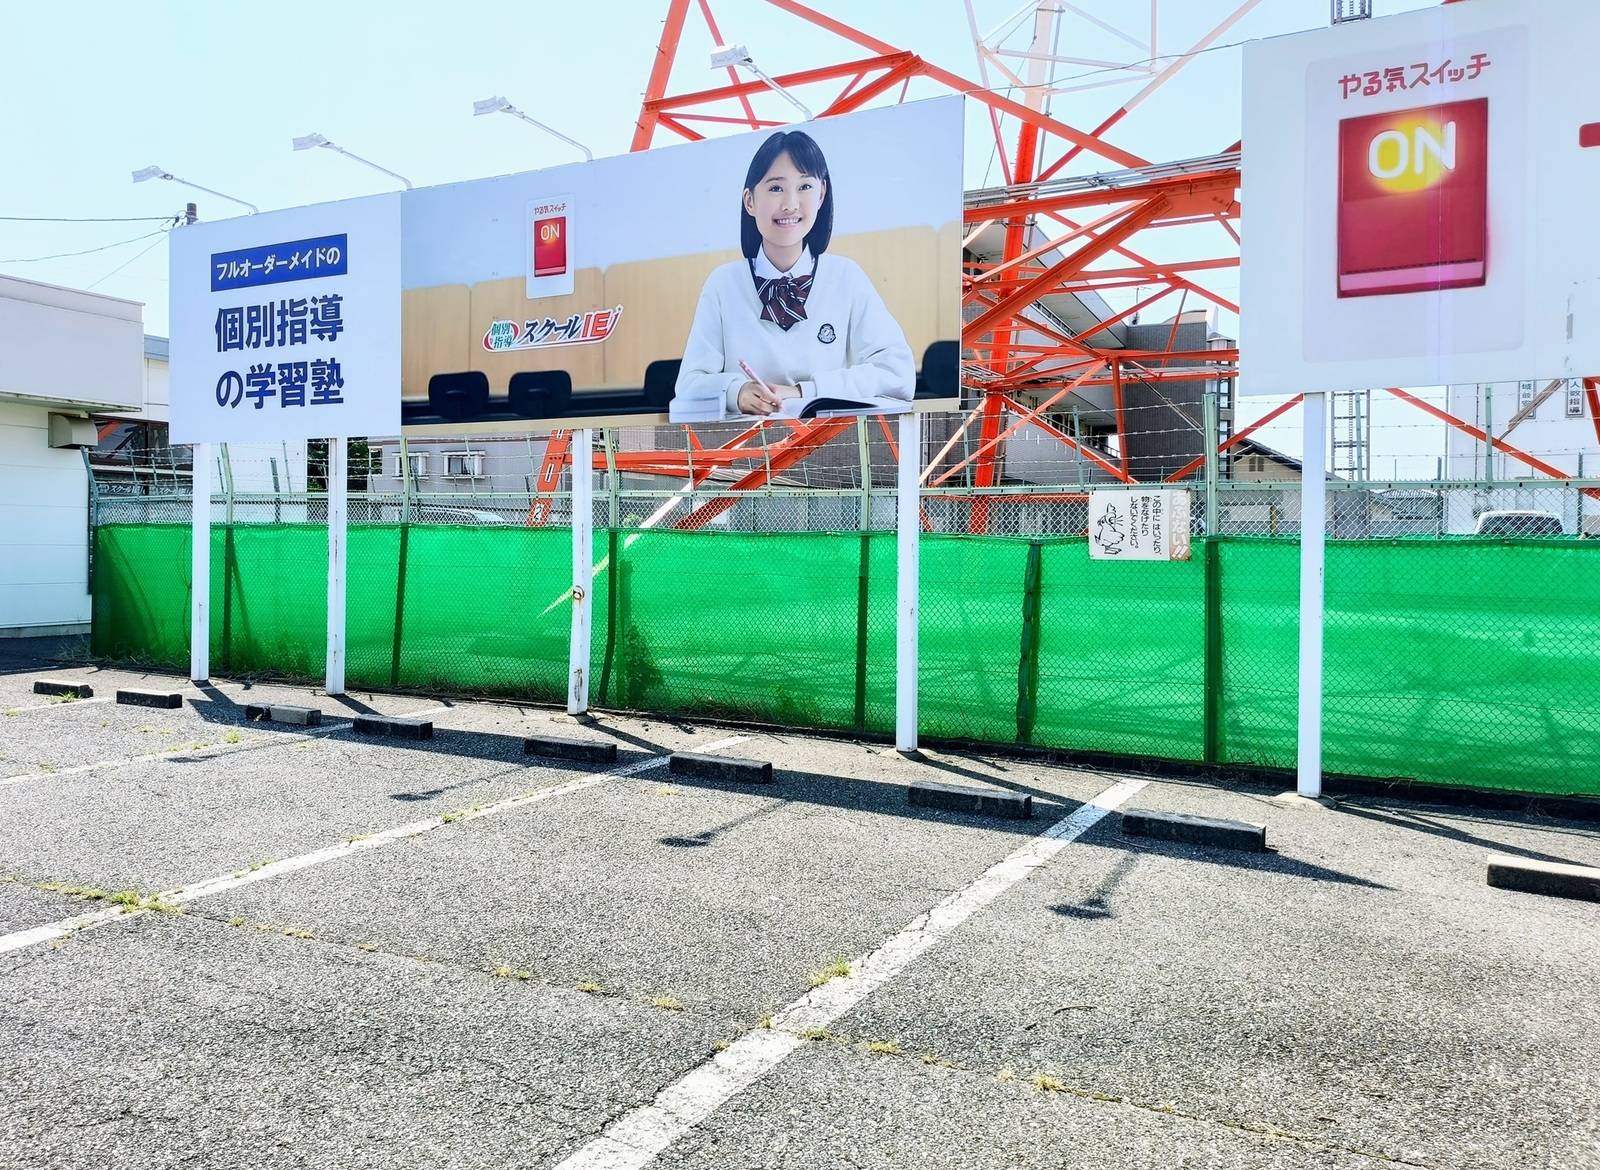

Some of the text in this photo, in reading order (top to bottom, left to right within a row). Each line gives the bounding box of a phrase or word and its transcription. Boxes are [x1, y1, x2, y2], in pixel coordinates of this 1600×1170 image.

[1338, 53, 1491, 99] やる気スイッチ
[1369, 121, 1456, 179] ON
[534, 203, 567, 215] やる気スイッチ
[540, 224, 560, 241] ON
[216, 247, 339, 280] フルオーダーメイドの
[215, 294, 343, 352] 個別指導
[216, 357, 344, 409] の学習塾
